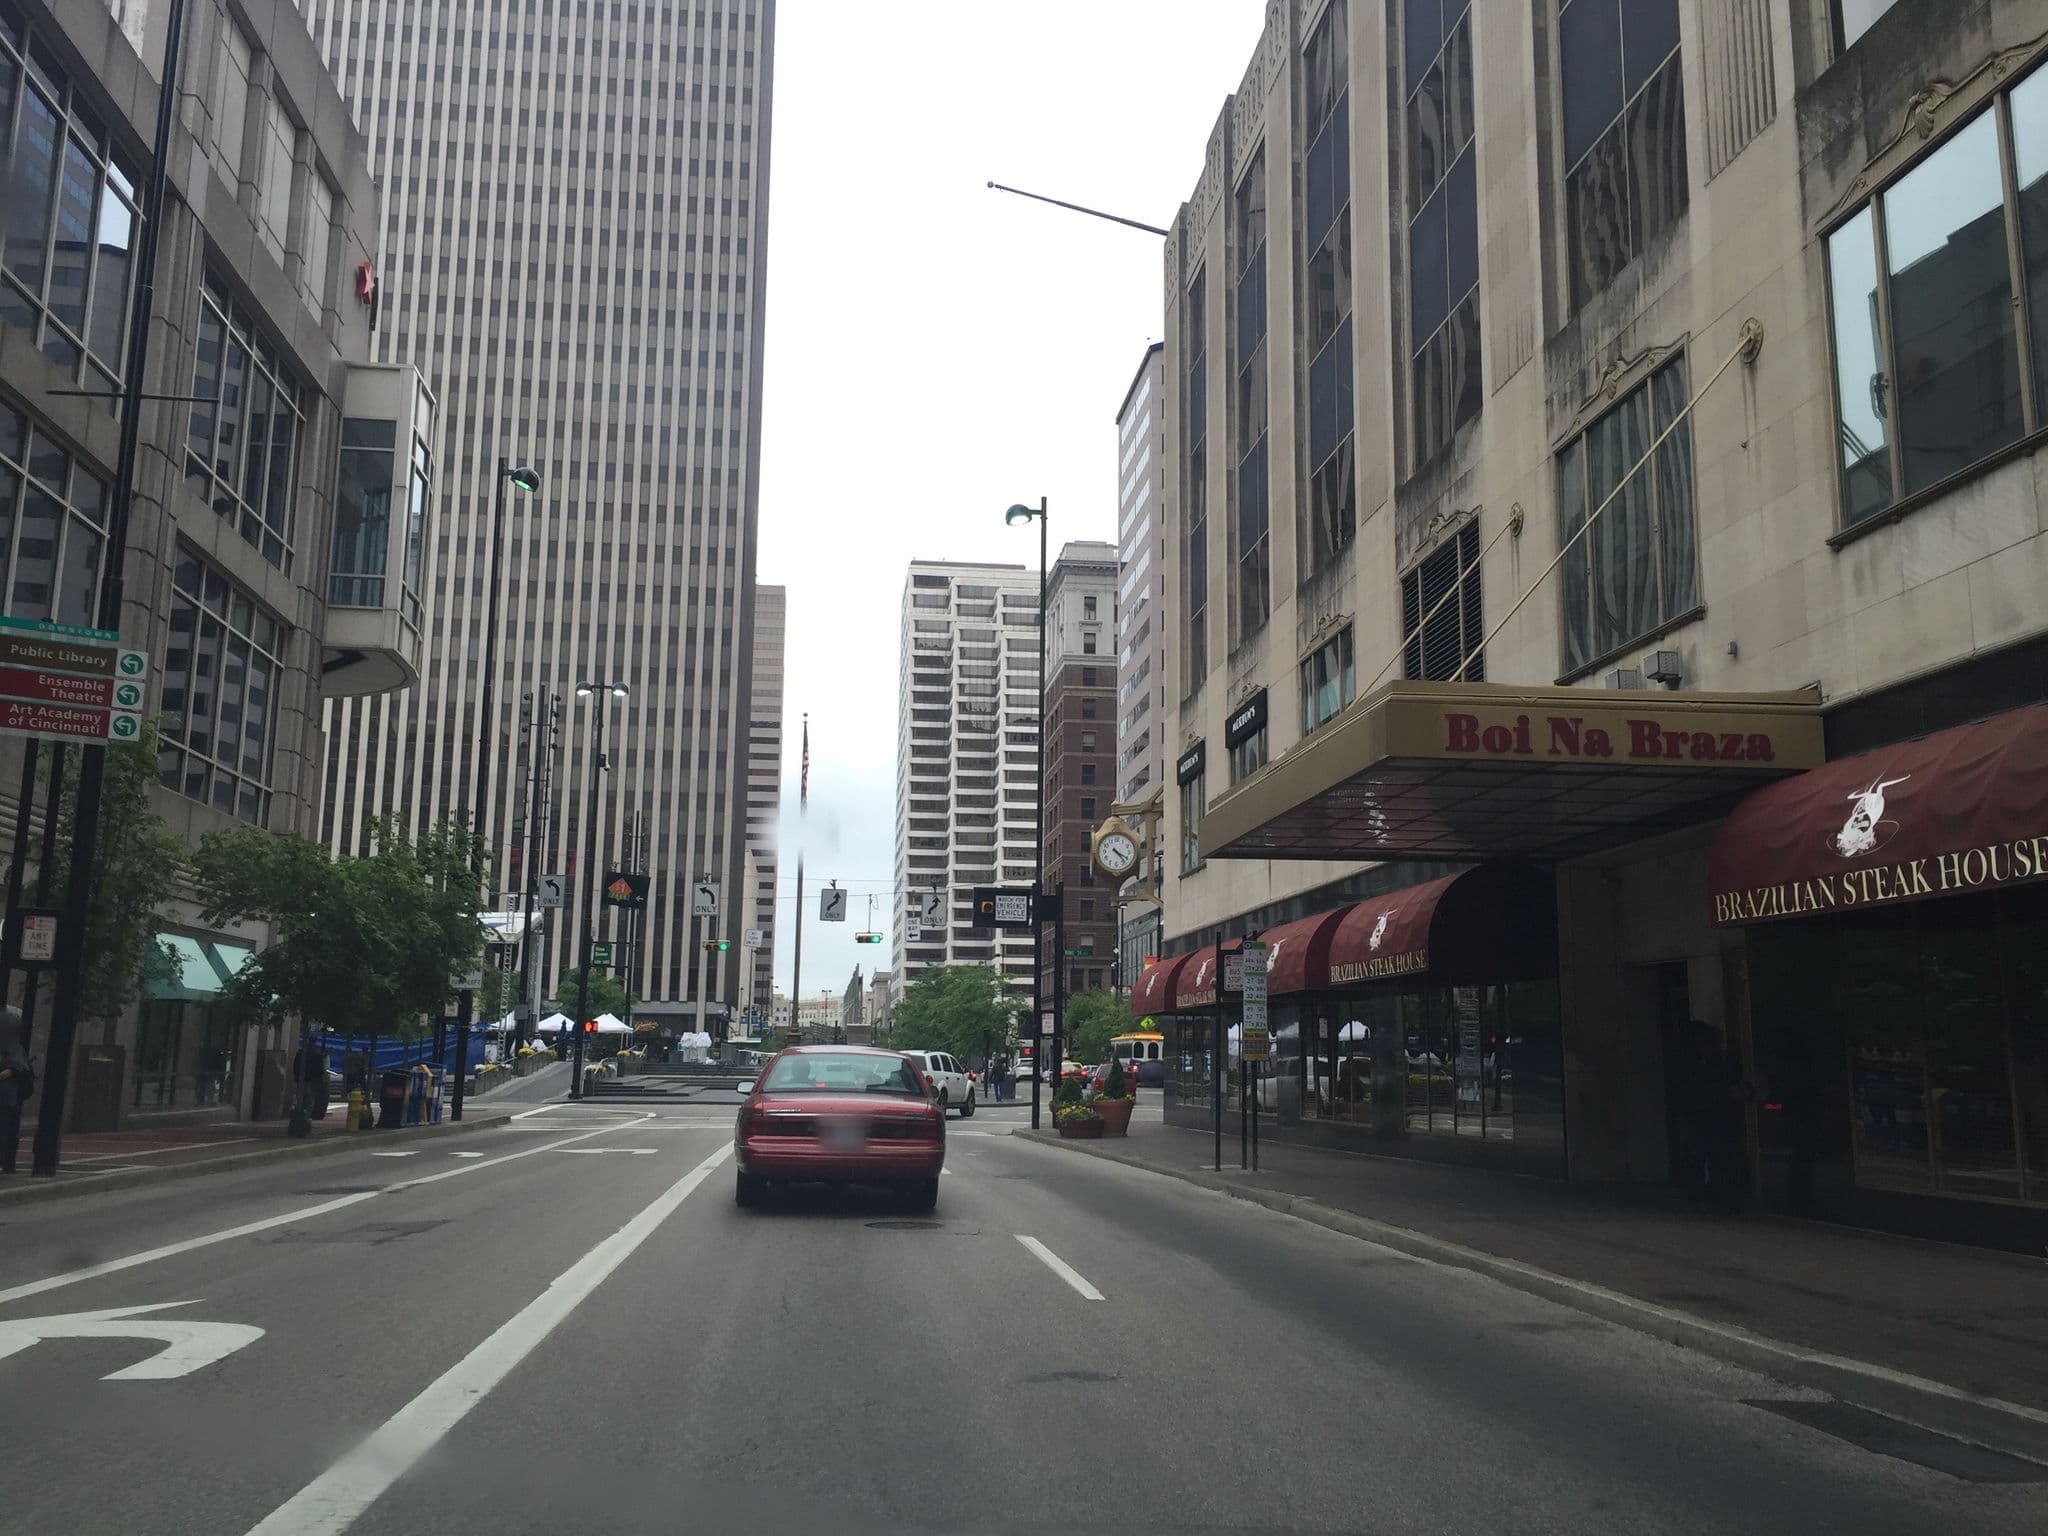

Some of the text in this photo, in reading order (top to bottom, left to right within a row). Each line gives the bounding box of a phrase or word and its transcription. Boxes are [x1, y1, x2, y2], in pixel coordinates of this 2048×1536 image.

[10, 644, 108, 667] Public Library
[38, 674, 106, 692] Ensemble
[50, 687, 105, 703] Theatre
[9, 703, 102, 724] Art Academy
[8, 716, 101, 735] of Cincinnati
[1444, 713, 1776, 763] Boi Na Braza
[1715, 836, 2048, 923] BRAZILIAN STEAK HOUSE
[543, 897, 561, 905] ONLY
[695, 905, 718, 913] ONLY
[825, 911, 840, 919] ONLY
[924, 916, 944, 924] ONLY
[30, 931, 49, 941] ANY
[1330, 949, 1426, 982] BRAZILIAN STEAK HOUSE
